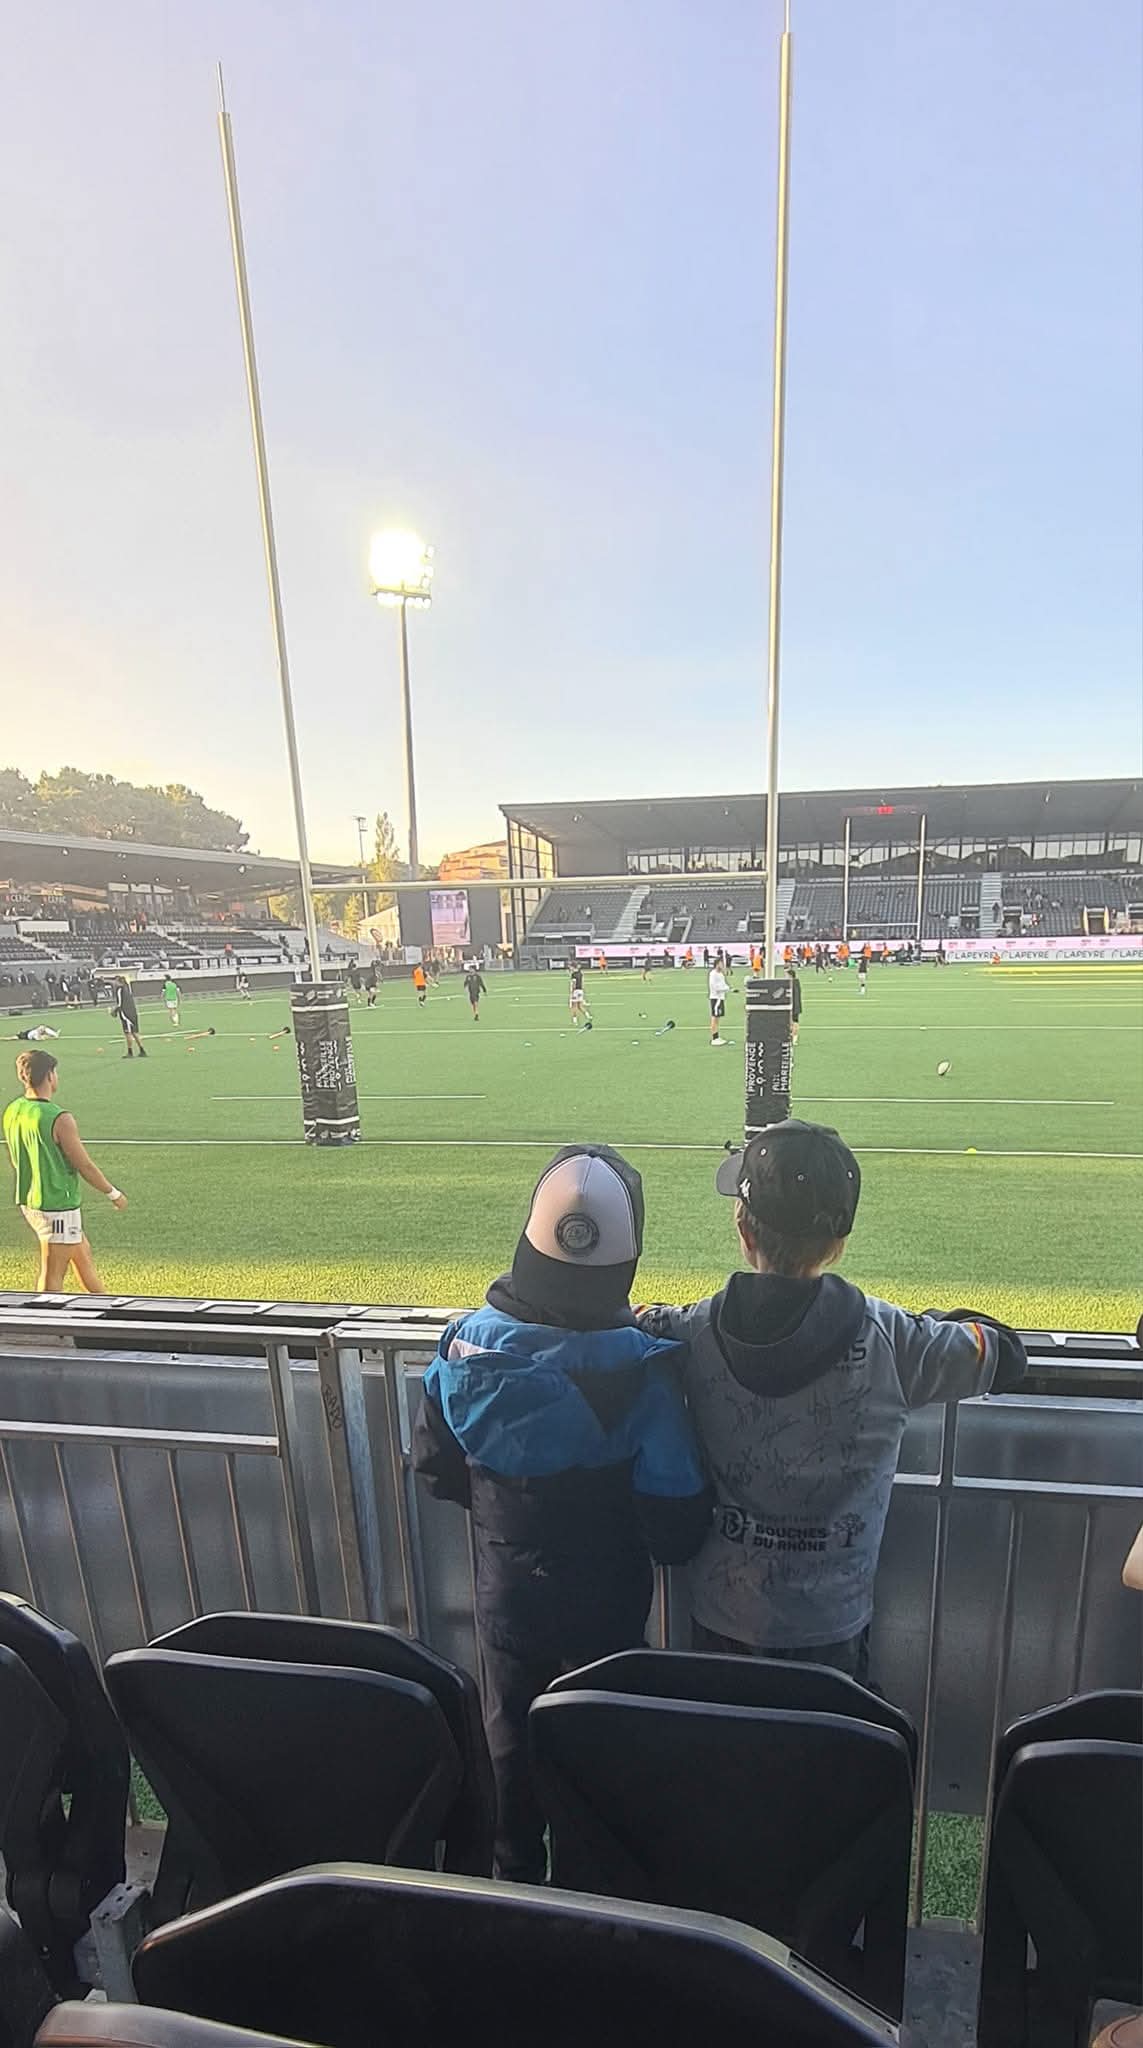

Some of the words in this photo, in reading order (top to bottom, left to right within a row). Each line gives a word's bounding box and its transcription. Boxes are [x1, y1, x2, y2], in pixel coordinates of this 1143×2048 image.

[954, 951, 995, 960] LAPEYRE
[1008, 950, 1049, 959] LAPEYRE
[1063, 950, 1105, 959] LAPEYRE
[748, 1042, 756, 1093] PROVENCE
[755, 1524, 827, 1539] BOUCHES
[753, 1536, 773, 1550] DU
